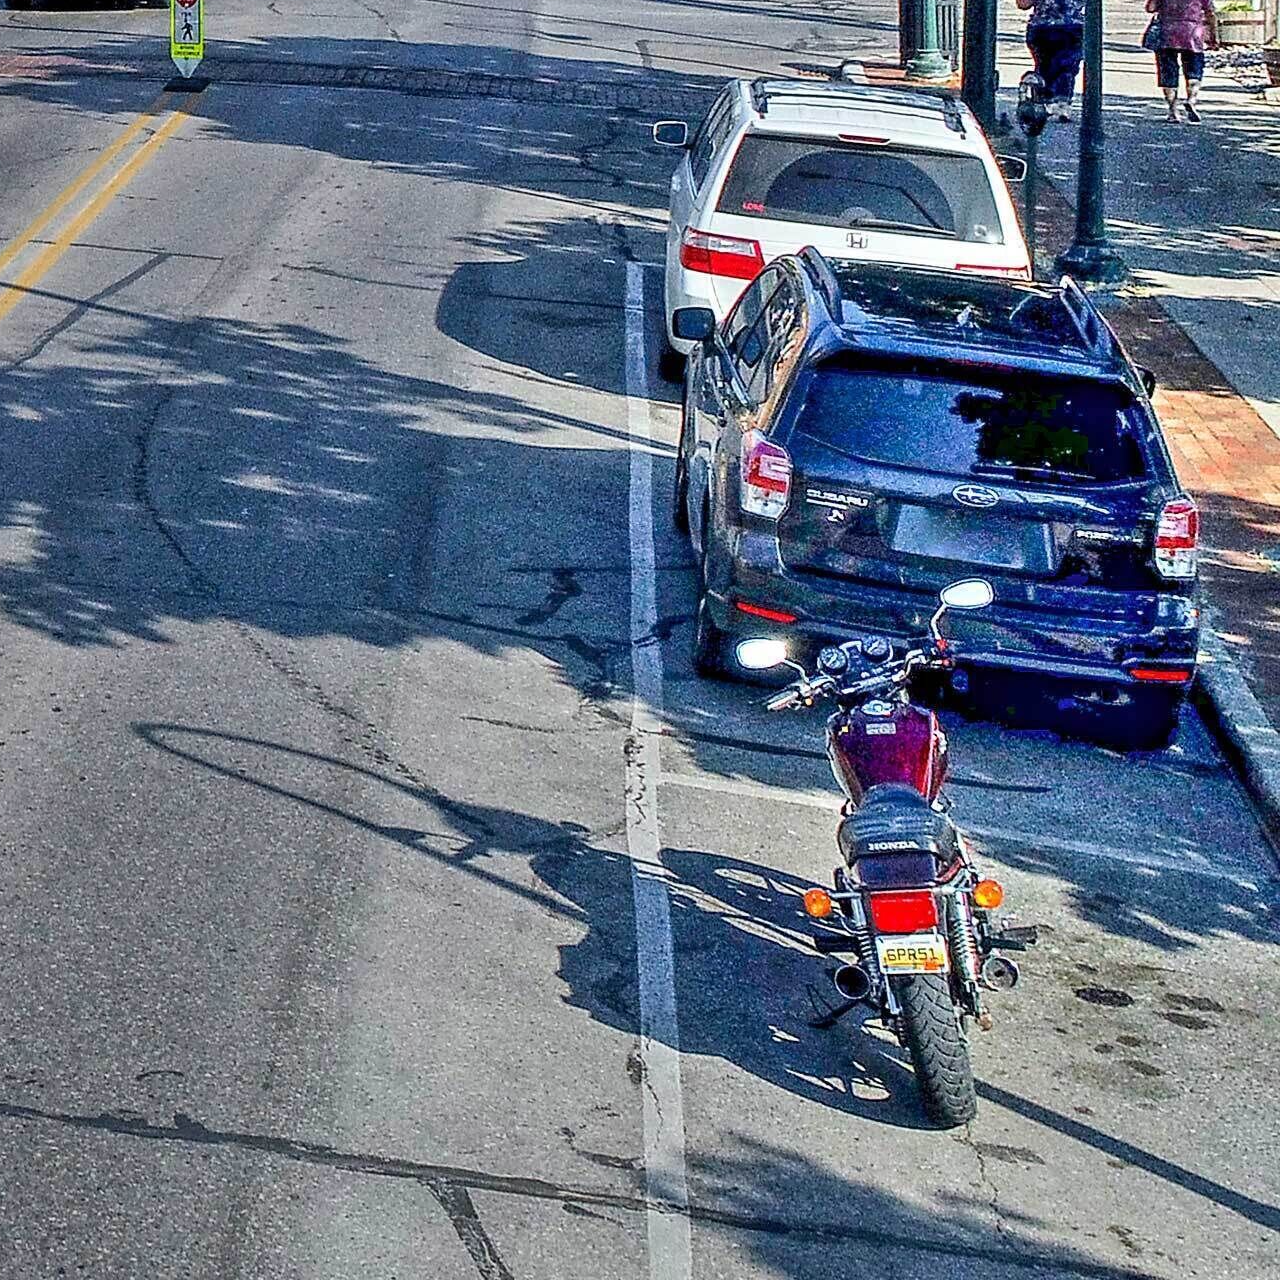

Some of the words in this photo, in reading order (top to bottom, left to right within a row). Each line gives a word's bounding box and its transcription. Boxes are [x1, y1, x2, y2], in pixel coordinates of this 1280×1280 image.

[806, 488, 869, 507] SUBARU
[868, 840, 921, 852] HONDA
[886, 947, 939, 962] 6PR51
